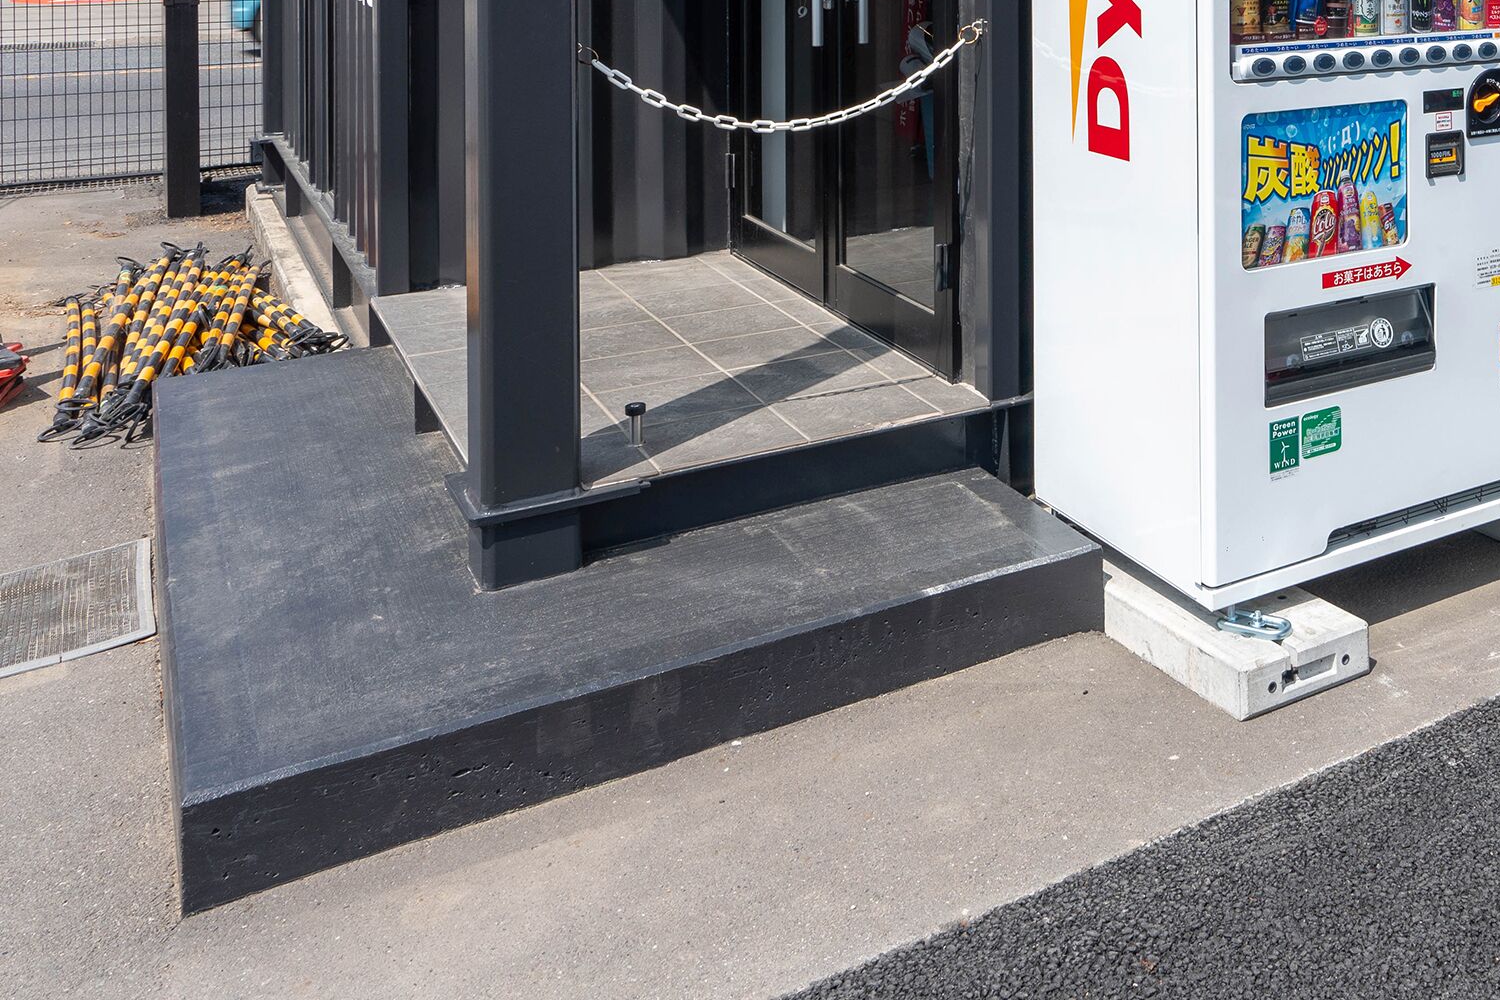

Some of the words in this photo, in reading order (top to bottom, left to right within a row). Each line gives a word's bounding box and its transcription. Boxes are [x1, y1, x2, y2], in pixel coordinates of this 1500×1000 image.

[1333, 261, 1402, 286] お菓子はあちら
[1273, 420, 1296, 431] Green
[1272, 428, 1297, 439] Power
[1274, 458, 1296, 470] WIND
